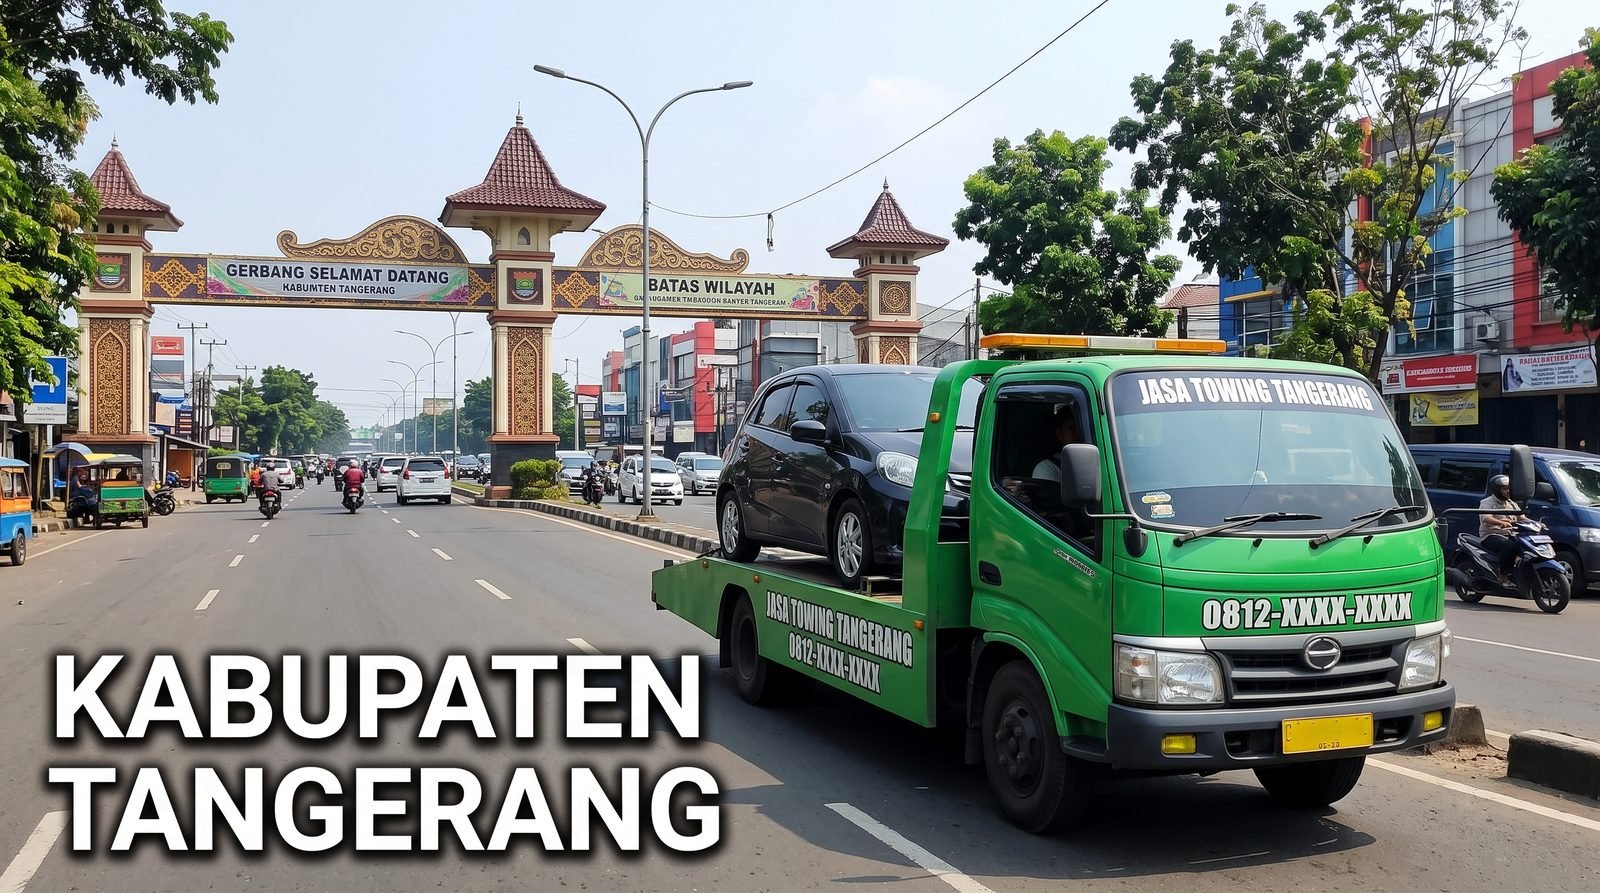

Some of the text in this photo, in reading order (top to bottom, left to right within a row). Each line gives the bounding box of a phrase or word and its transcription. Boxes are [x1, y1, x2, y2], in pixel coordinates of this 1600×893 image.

[226, 263, 449, 284] GERBANG SELAMAT DATANG
[648, 278, 775, 296] BATAS WILAYAH
[338, 285, 396, 295] TANGERANG
[750, 298, 787, 306] TANGERAM
[1137, 377, 1374, 411] JASA TOWING TANGERANG
[1202, 592, 1413, 630] 0812-XXXX-XXXX
[766, 590, 913, 668] JASA TOWING TANGERANG
[788, 631, 881, 694] 0812-XXXX-XXXX
